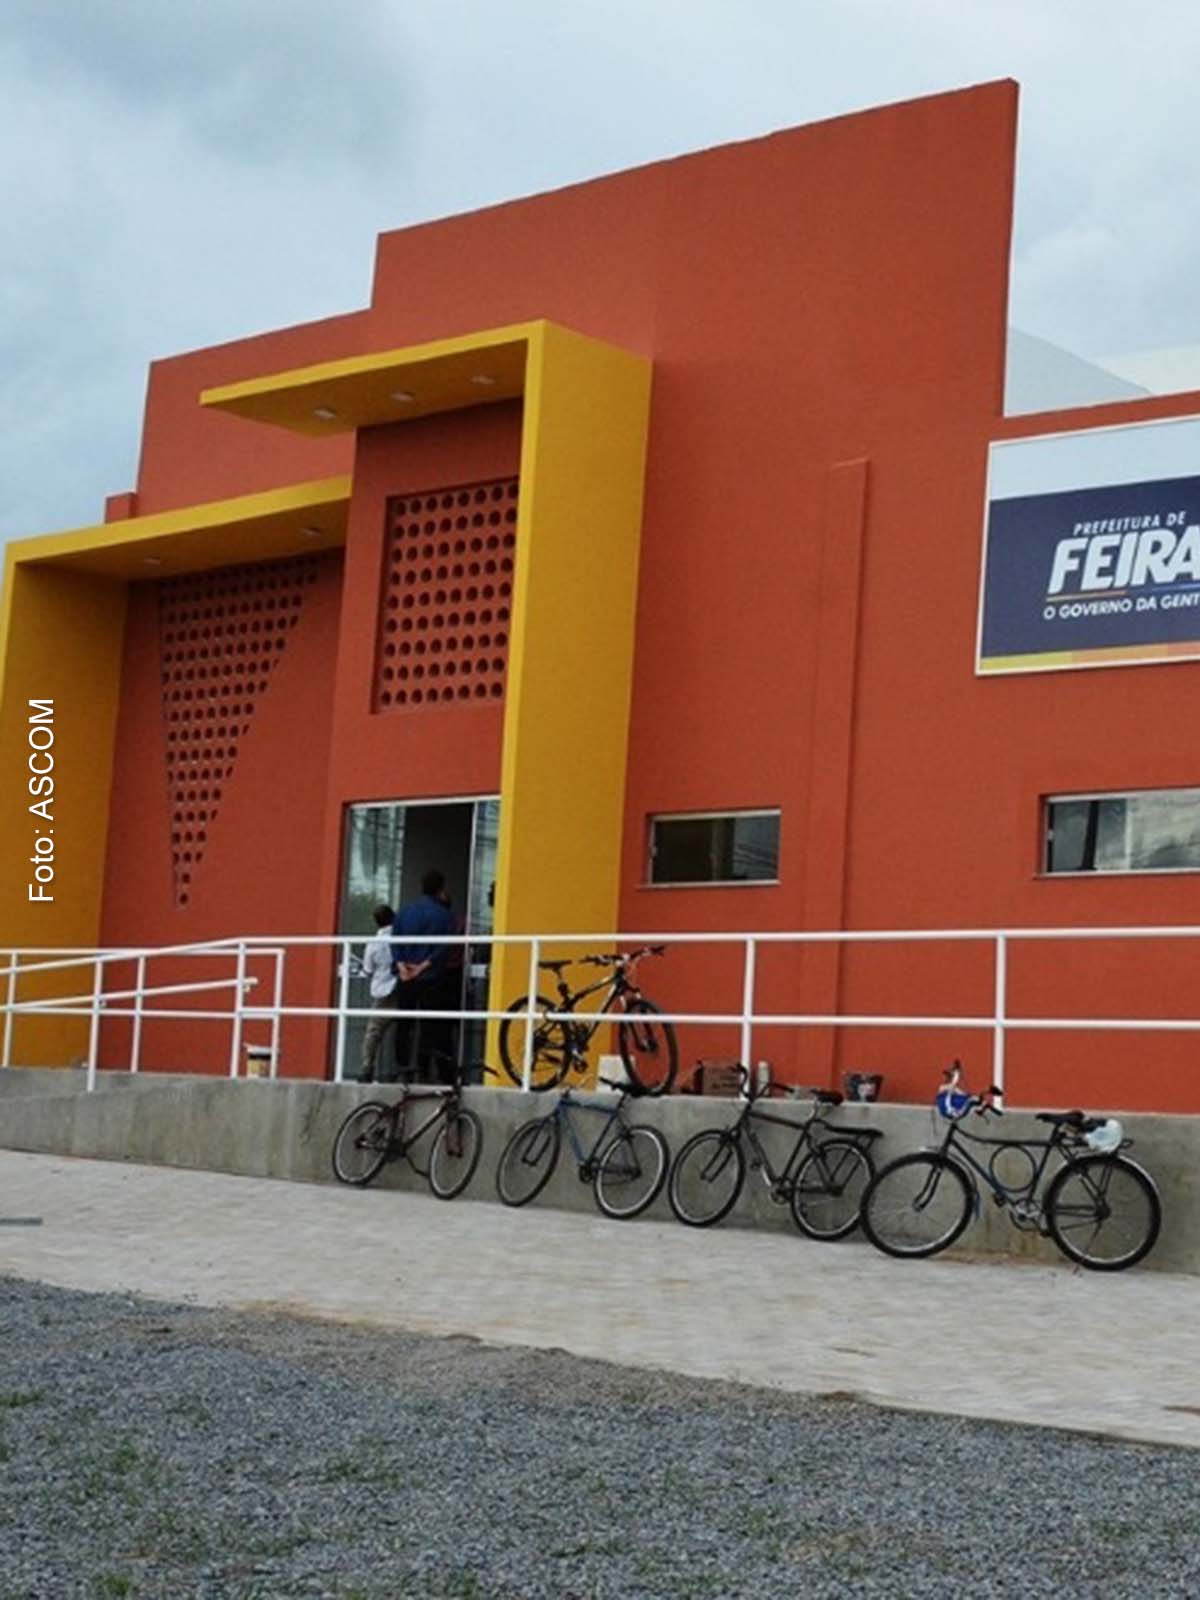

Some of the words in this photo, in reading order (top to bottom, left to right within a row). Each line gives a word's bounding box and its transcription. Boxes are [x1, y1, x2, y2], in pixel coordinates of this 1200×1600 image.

[1073, 514, 1160, 536] PREFEITURA
[1166, 511, 1186, 526] DE
[1043, 607, 1055, 620] O
[1059, 599, 1132, 619] GOVERNO
[1136, 597, 1157, 611] DA
